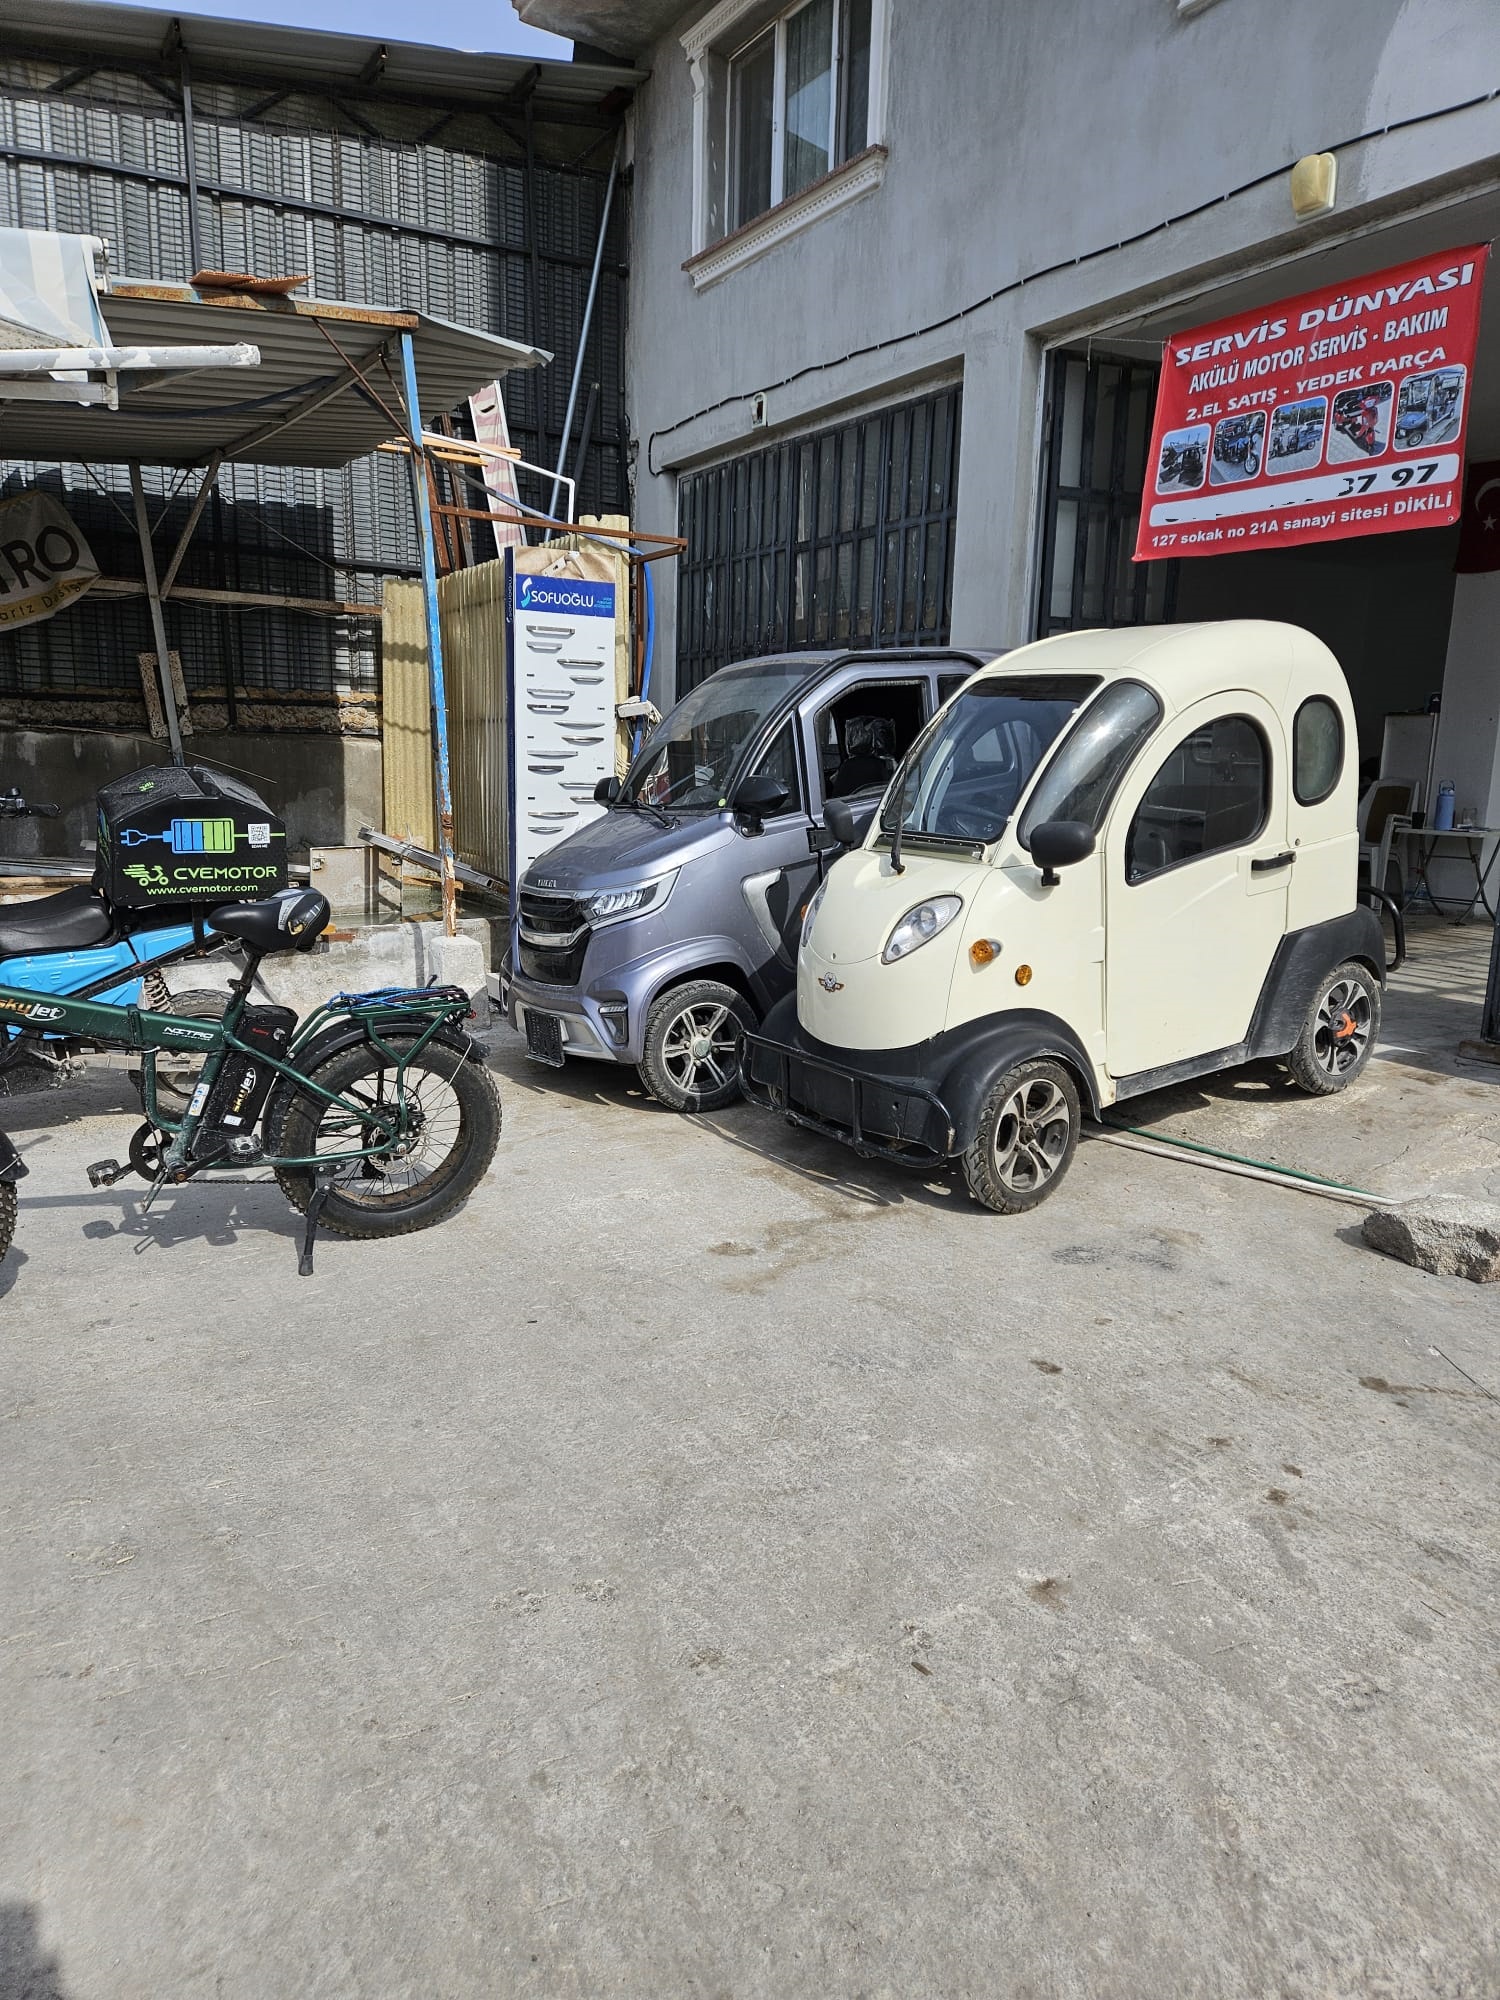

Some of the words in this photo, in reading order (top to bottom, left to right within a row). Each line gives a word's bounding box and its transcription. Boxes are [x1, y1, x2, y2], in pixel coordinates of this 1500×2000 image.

[1176, 318, 1287, 366] SERVİS
[1298, 262, 1475, 331] DÜNYASI
[1188, 359, 1239, 395] AKÜLÜ
[1242, 346, 1304, 380] MOTOR
[1308, 325, 1368, 363] SERVİS
[1383, 306, 1449, 343] BAKIM
[1186, 403, 1222, 421] 2.EL
[1227, 387, 1277, 405] SATIŞ
[1296, 365, 1364, 394] YEDEK
[1369, 347, 1446, 377] PARÇA
[1391, 463, 1439, 488] 97
[1151, 533, 1177, 547] 127
[1180, 528, 1223, 544] sokak
[1227, 527, 1246, 538] no
[1250, 520, 1279, 535] 21A
[1283, 511, 1336, 531] sanayi
[1340, 504, 1389, 522] sitesi
[1393, 491, 1453, 514] DİKİLİ
[531, 590, 594, 607] SOFUOĞLU
[174, 866, 277, 880] CVEMOTOR
[147, 885, 258, 895] www.cvemotor.com
[164, 1026, 214, 1039] NITRO
